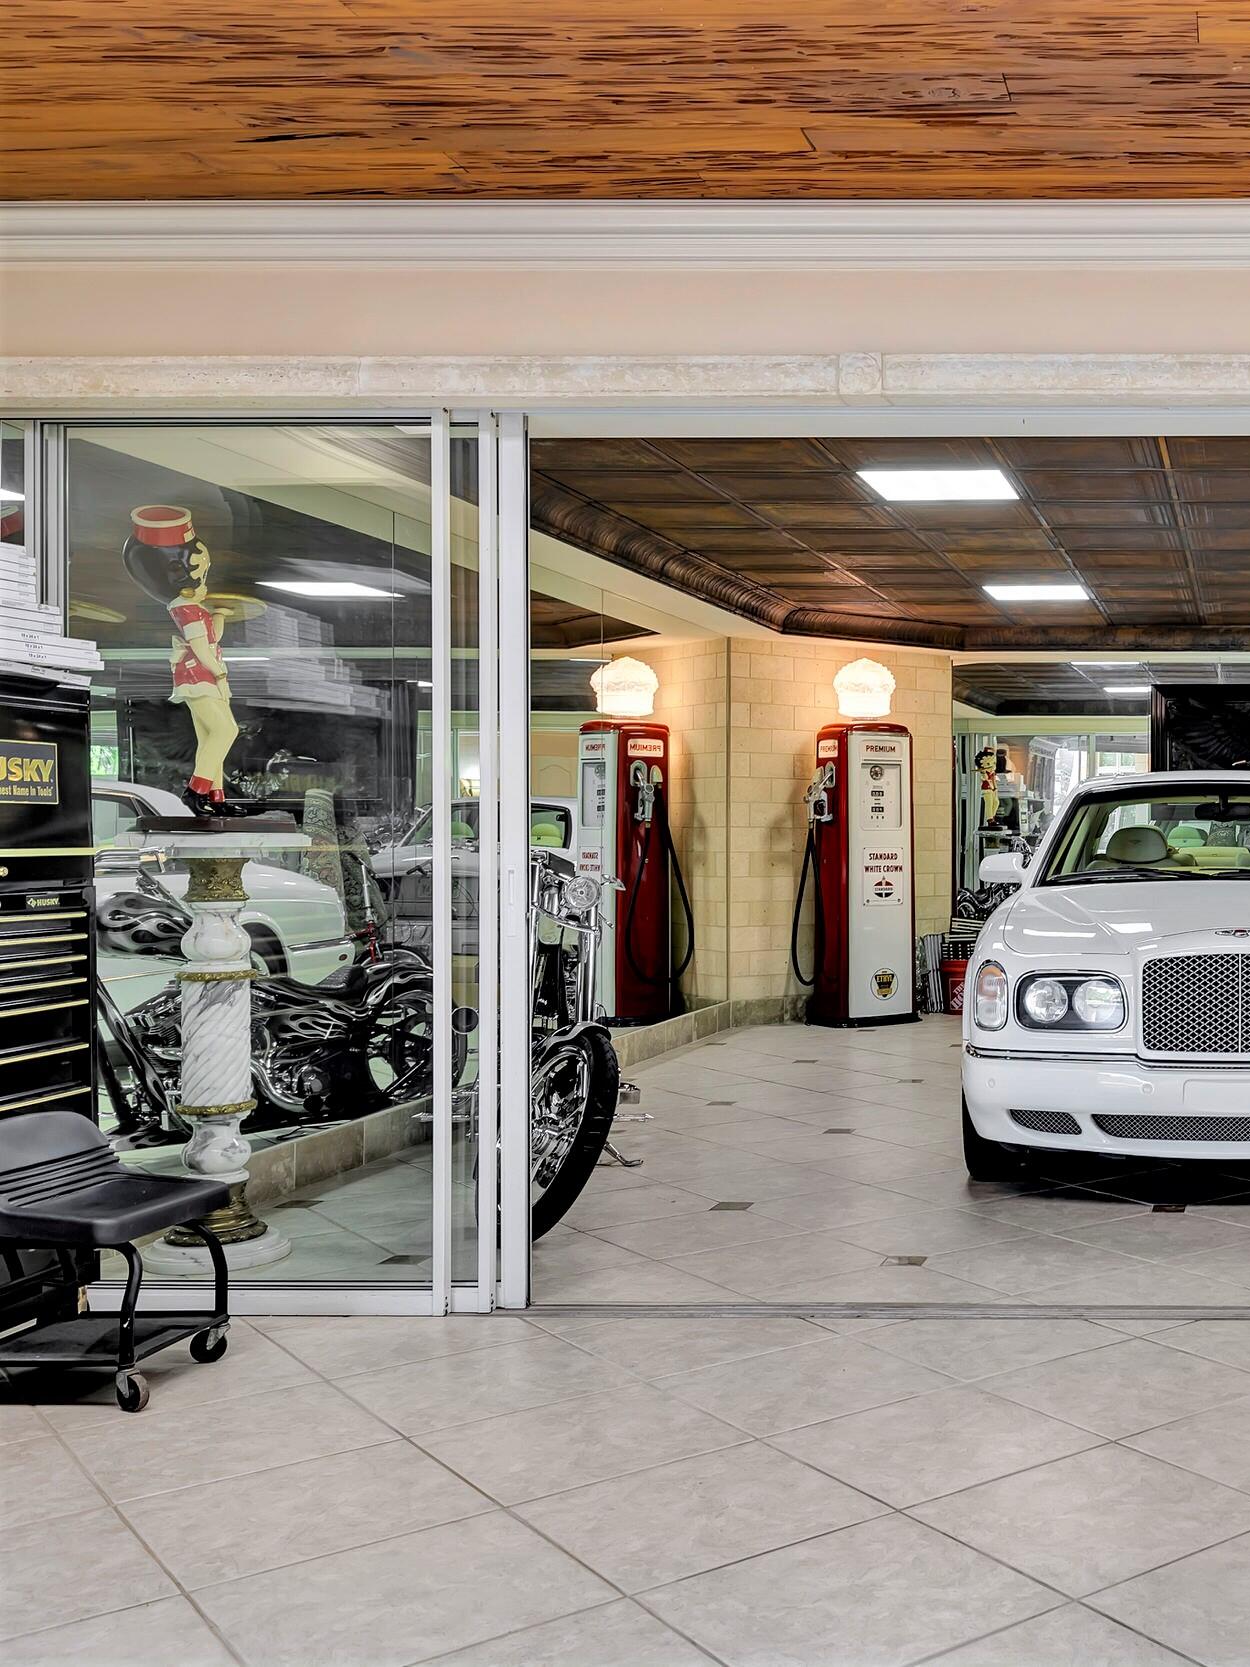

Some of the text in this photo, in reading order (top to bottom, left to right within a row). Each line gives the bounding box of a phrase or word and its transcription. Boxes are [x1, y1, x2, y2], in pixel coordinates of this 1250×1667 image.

[865, 744, 896, 753] PREMIUM
[13, 785, 29, 796] Name
[37, 786, 52, 797] Tools
[36, 898, 59, 906] HUSKY
